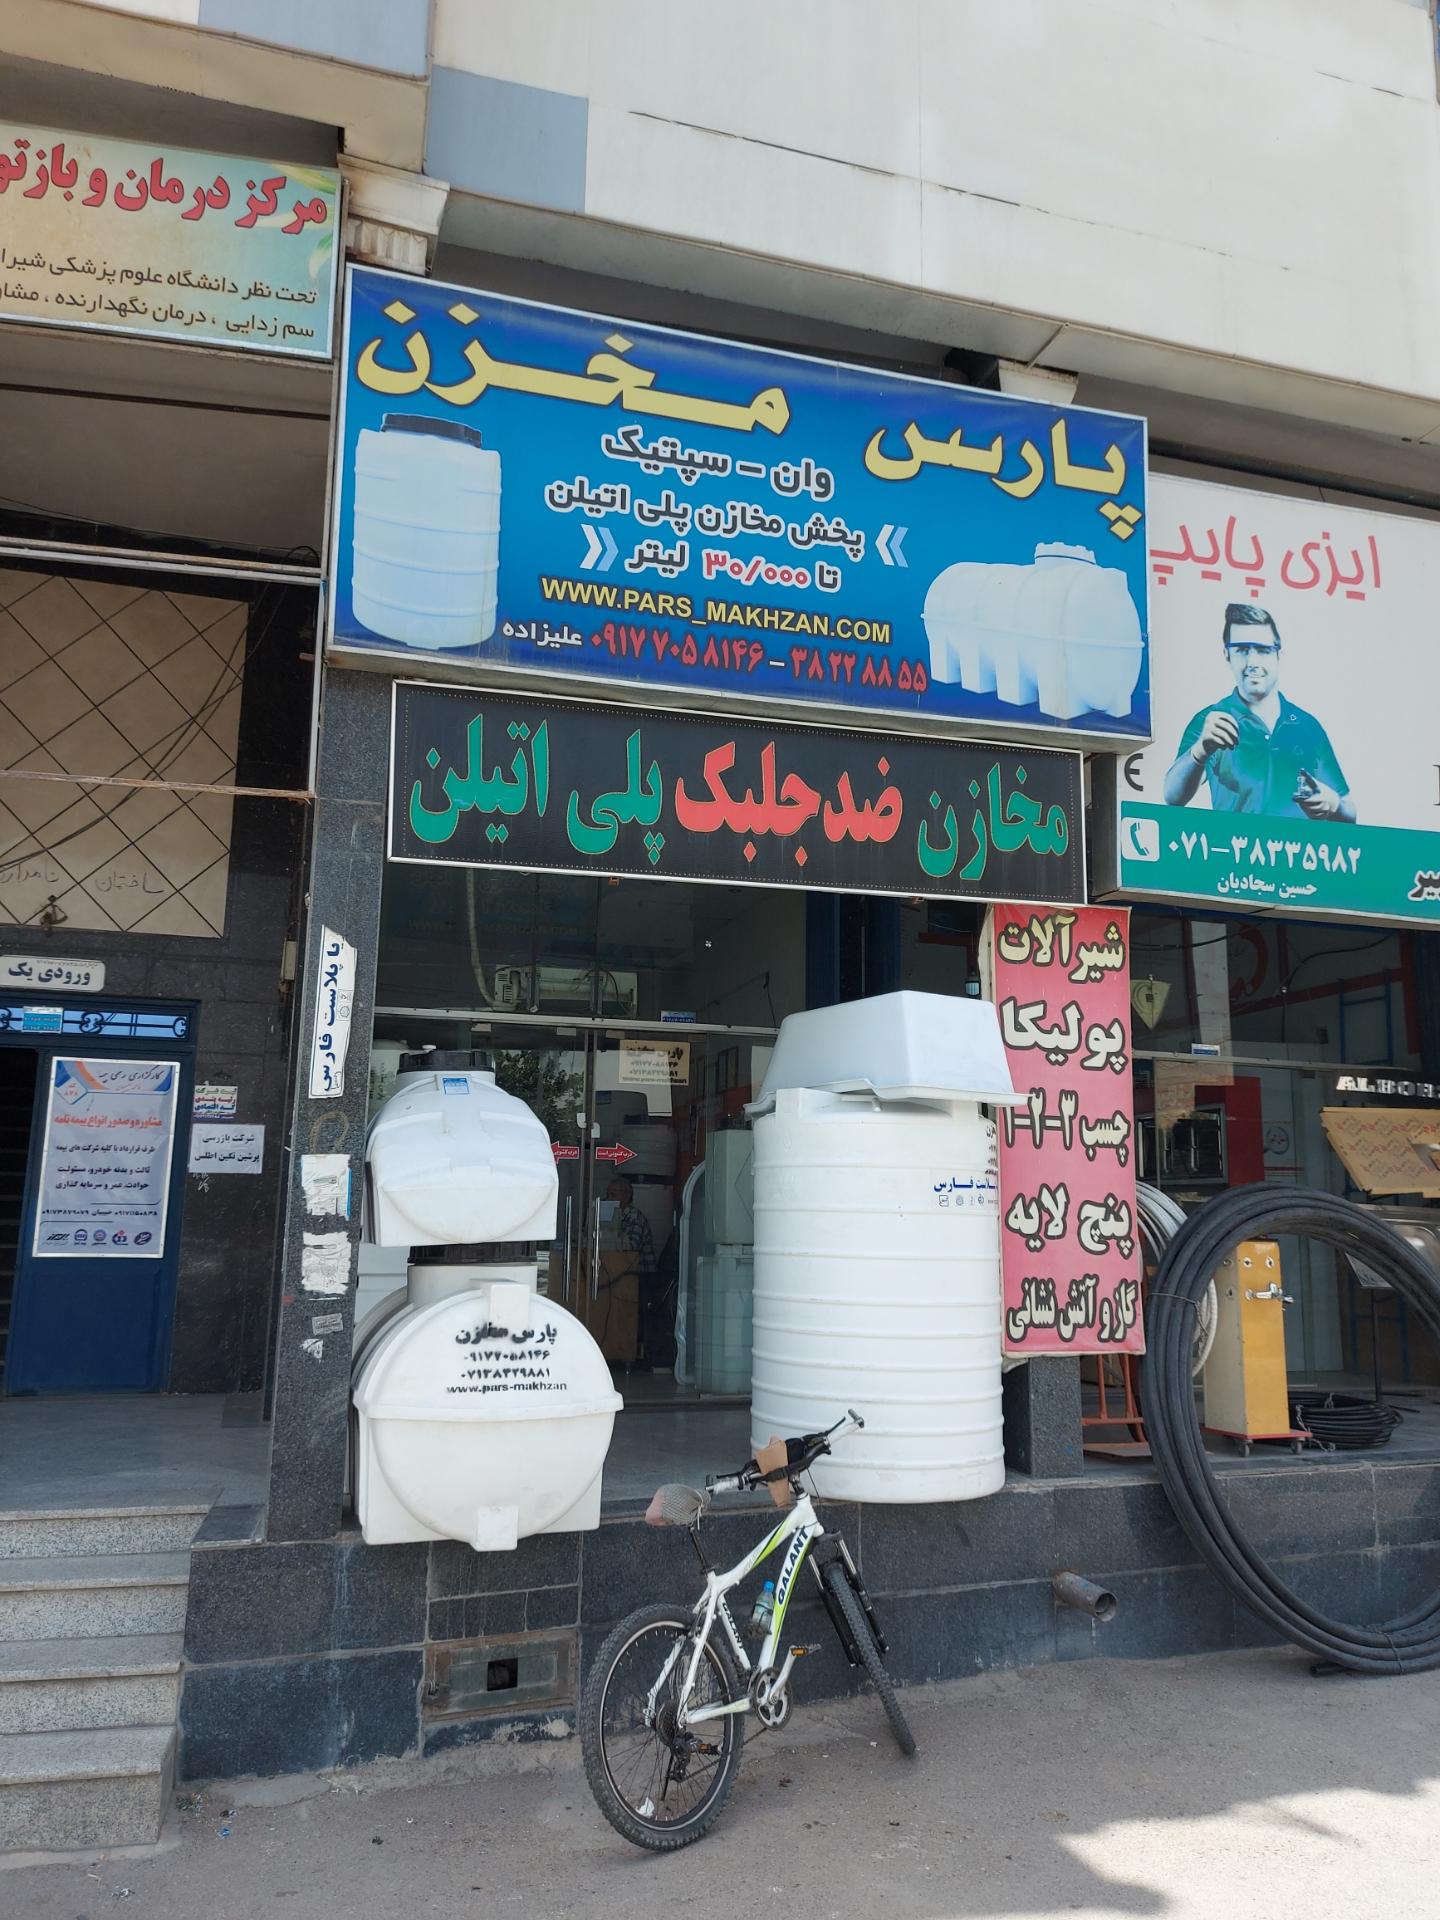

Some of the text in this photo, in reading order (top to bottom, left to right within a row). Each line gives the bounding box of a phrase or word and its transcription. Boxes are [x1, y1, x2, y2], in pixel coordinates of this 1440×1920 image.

[82, 167, 108, 207] و
[114, 157, 231, 221] درمان
[235, 176, 328, 235] مرکز
[0, 248, 318, 305] تحت نظر دانشگاه علوم پزشکی شیرا
[54, 293, 148, 318] نگهدارنده
[152, 303, 207, 325] درمان
[225, 313, 279, 337] زدایی
[282, 320, 315, 339] سم
[356, 300, 1142, 541] پارس مخزن
[601, 425, 732, 485] سپتیک
[772, 458, 835, 501] وان
[545, 476, 865, 561] پخش مخازن پلی اتیلن
[625, 539, 690, 577] لیتر
[815, 561, 841, 592] تا
[1149, 516, 1381, 601] ایزی پایپ
[541, 576, 892, 643] WWW.PARS_MAKHZAN.COM
[502, 620, 583, 649] علیزاده
[410, 713, 1069, 880] مخازن ضد جلبک پلی اتیلن
[1217, 872, 1317, 899] حسین سجادیان
[8, 962, 33, 981] یک
[38, 967, 91, 986] ورودی
[202, 1133, 255, 1144] شرکت بازرسی
[1080, 1110, 1131, 1167] چسب
[933, 1175, 974, 1192] فارس
[1005, 1182, 1070, 1252] لایه
[1006, 1273, 1138, 1343] گاز و آتش نشانی
[511, 1323, 557, 1345] پارس
[777, 1525, 810, 1605] GALANT
